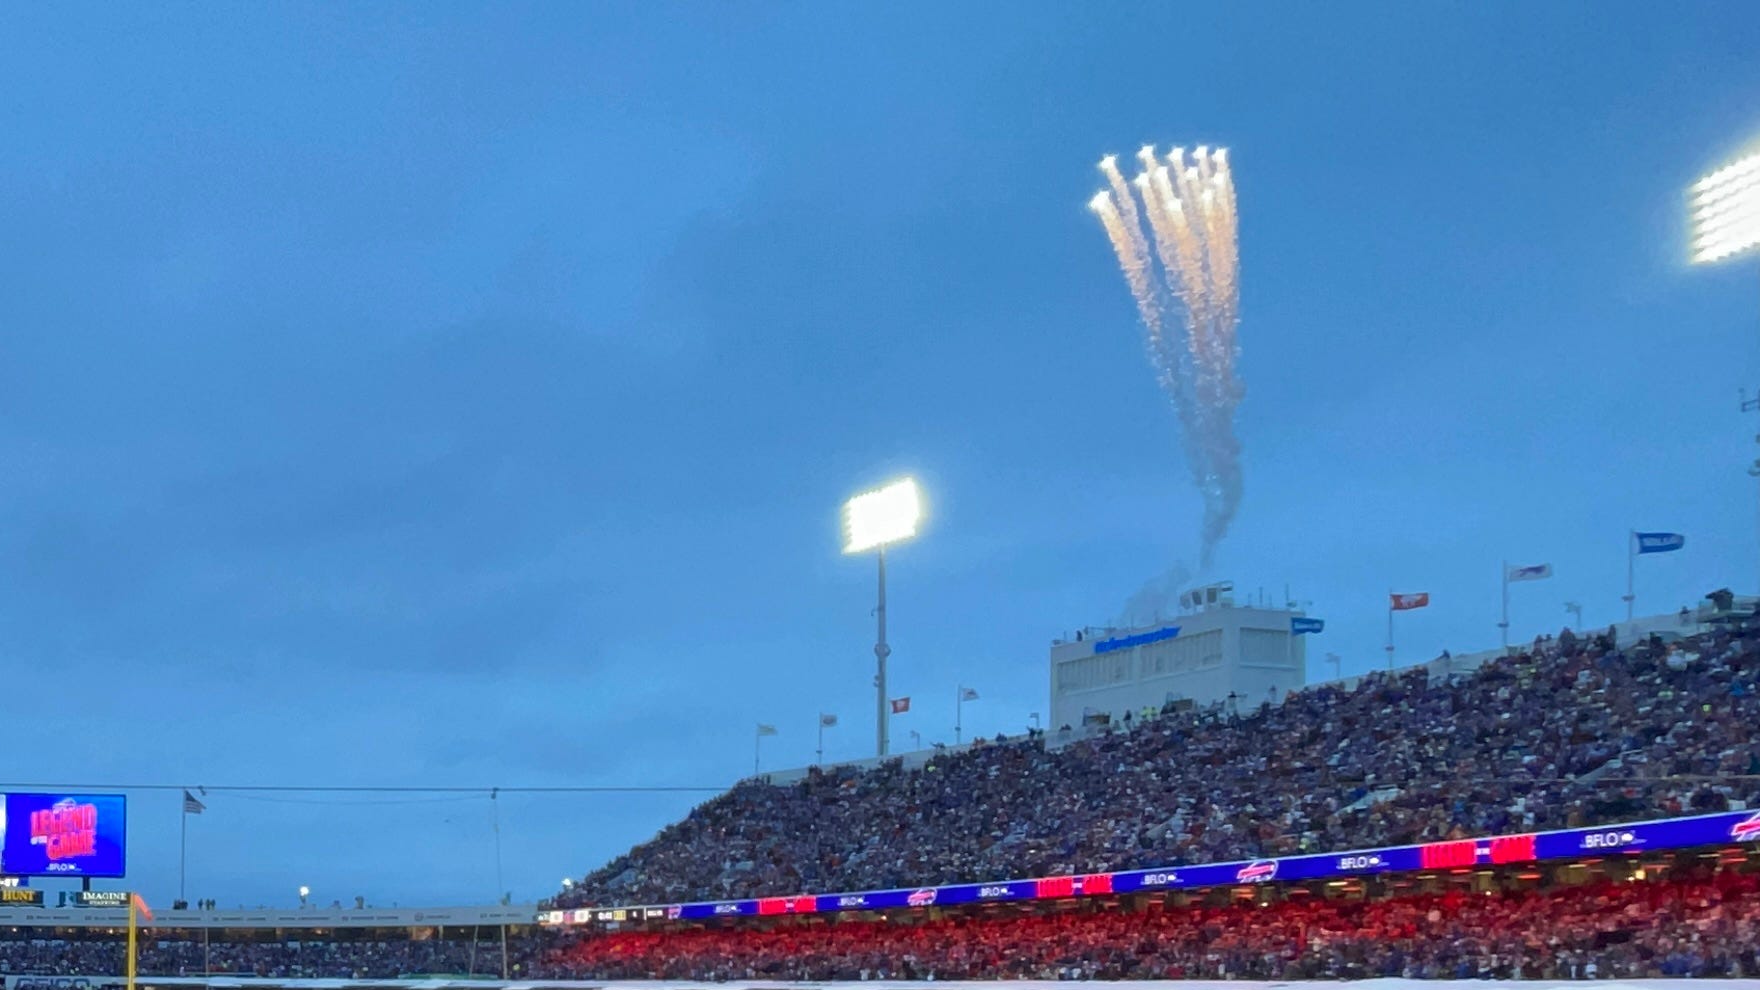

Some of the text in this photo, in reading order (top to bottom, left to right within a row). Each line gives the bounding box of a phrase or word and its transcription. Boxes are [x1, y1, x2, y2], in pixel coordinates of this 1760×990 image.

[1585, 833, 1619, 848] BFLO
[1341, 856, 1367, 869] BFLO
[2, 890, 34, 901] HUNT
[83, 891, 127, 901] IMAGINE
